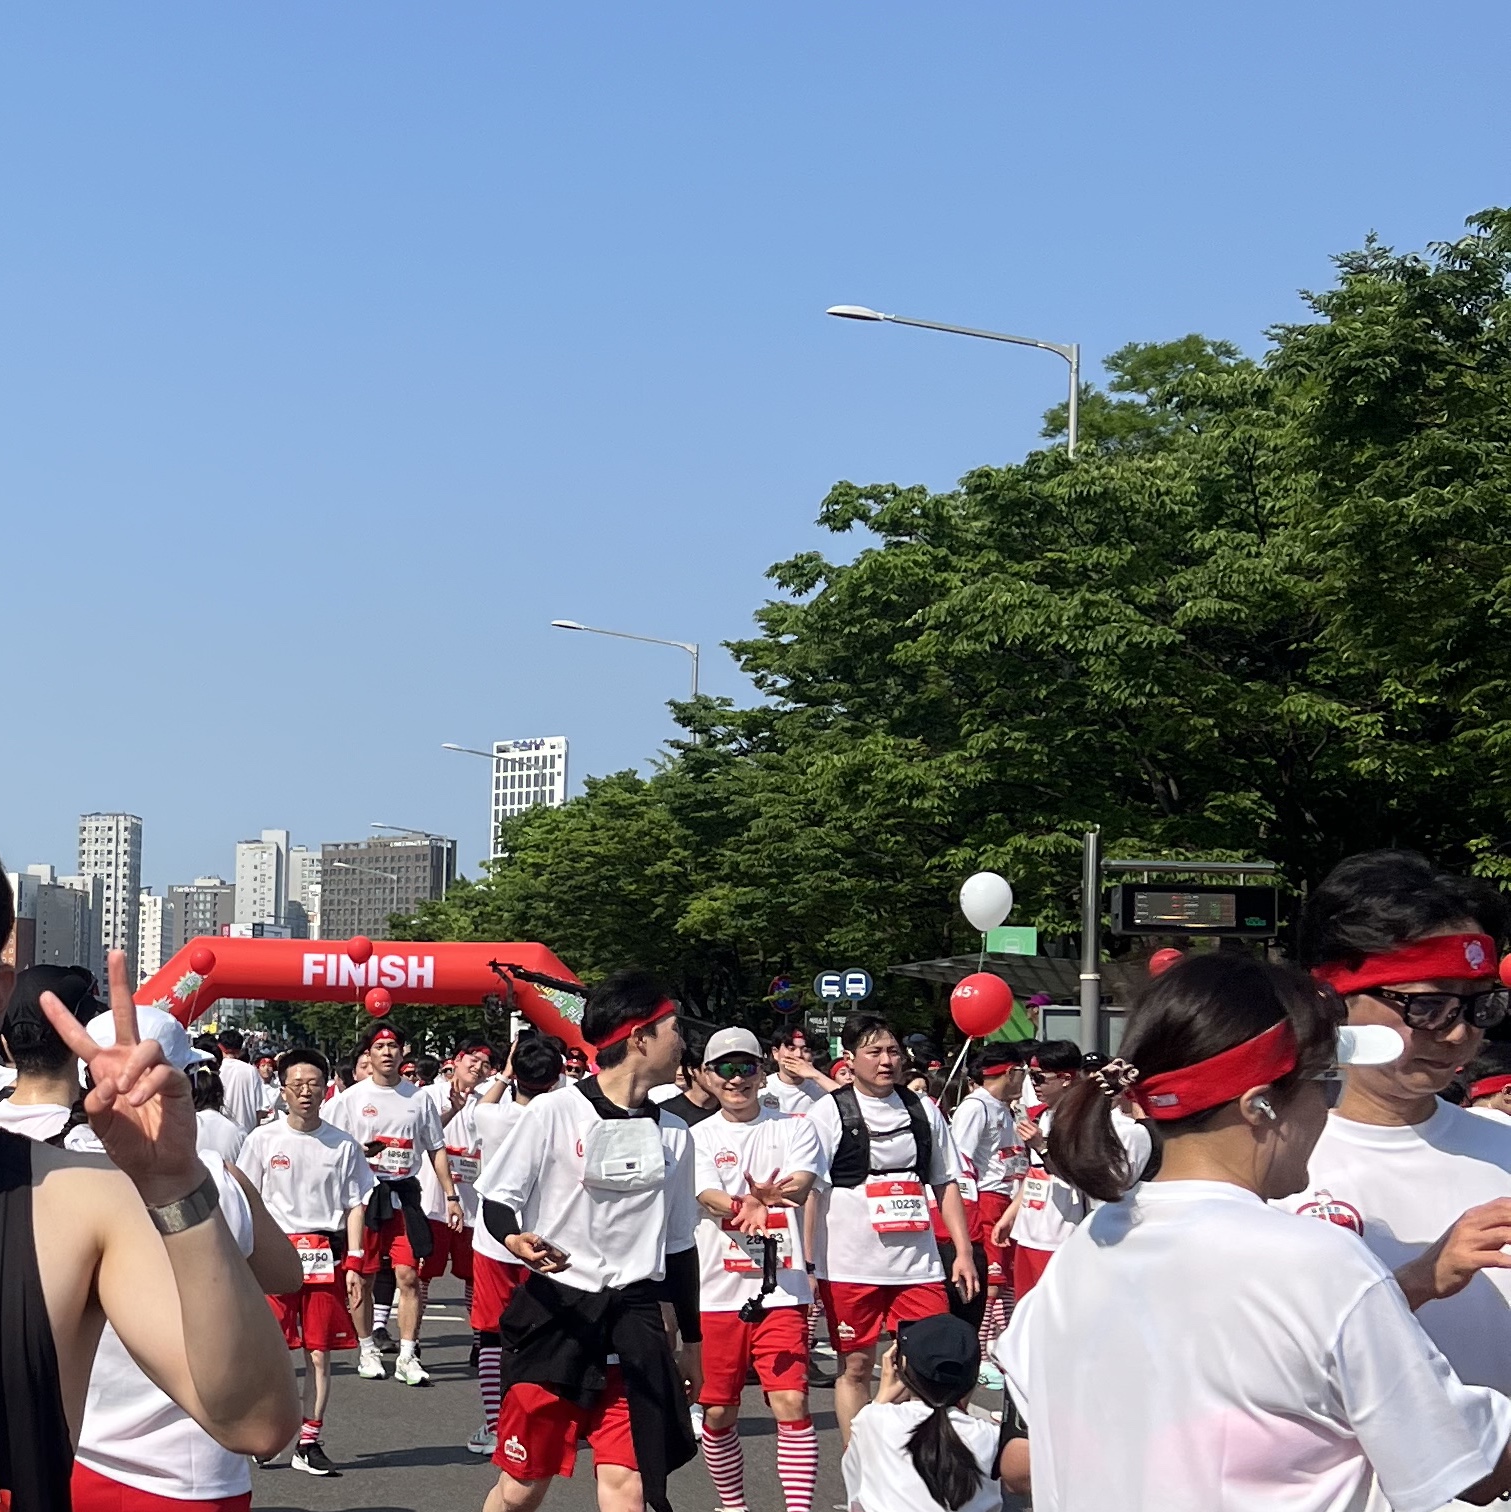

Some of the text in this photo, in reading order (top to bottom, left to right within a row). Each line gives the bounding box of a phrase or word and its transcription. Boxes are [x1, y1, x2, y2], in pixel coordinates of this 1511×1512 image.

[302, 953, 435, 989] FINISH
[875, 1203, 886, 1215] A
[728, 1239, 740, 1251] A
